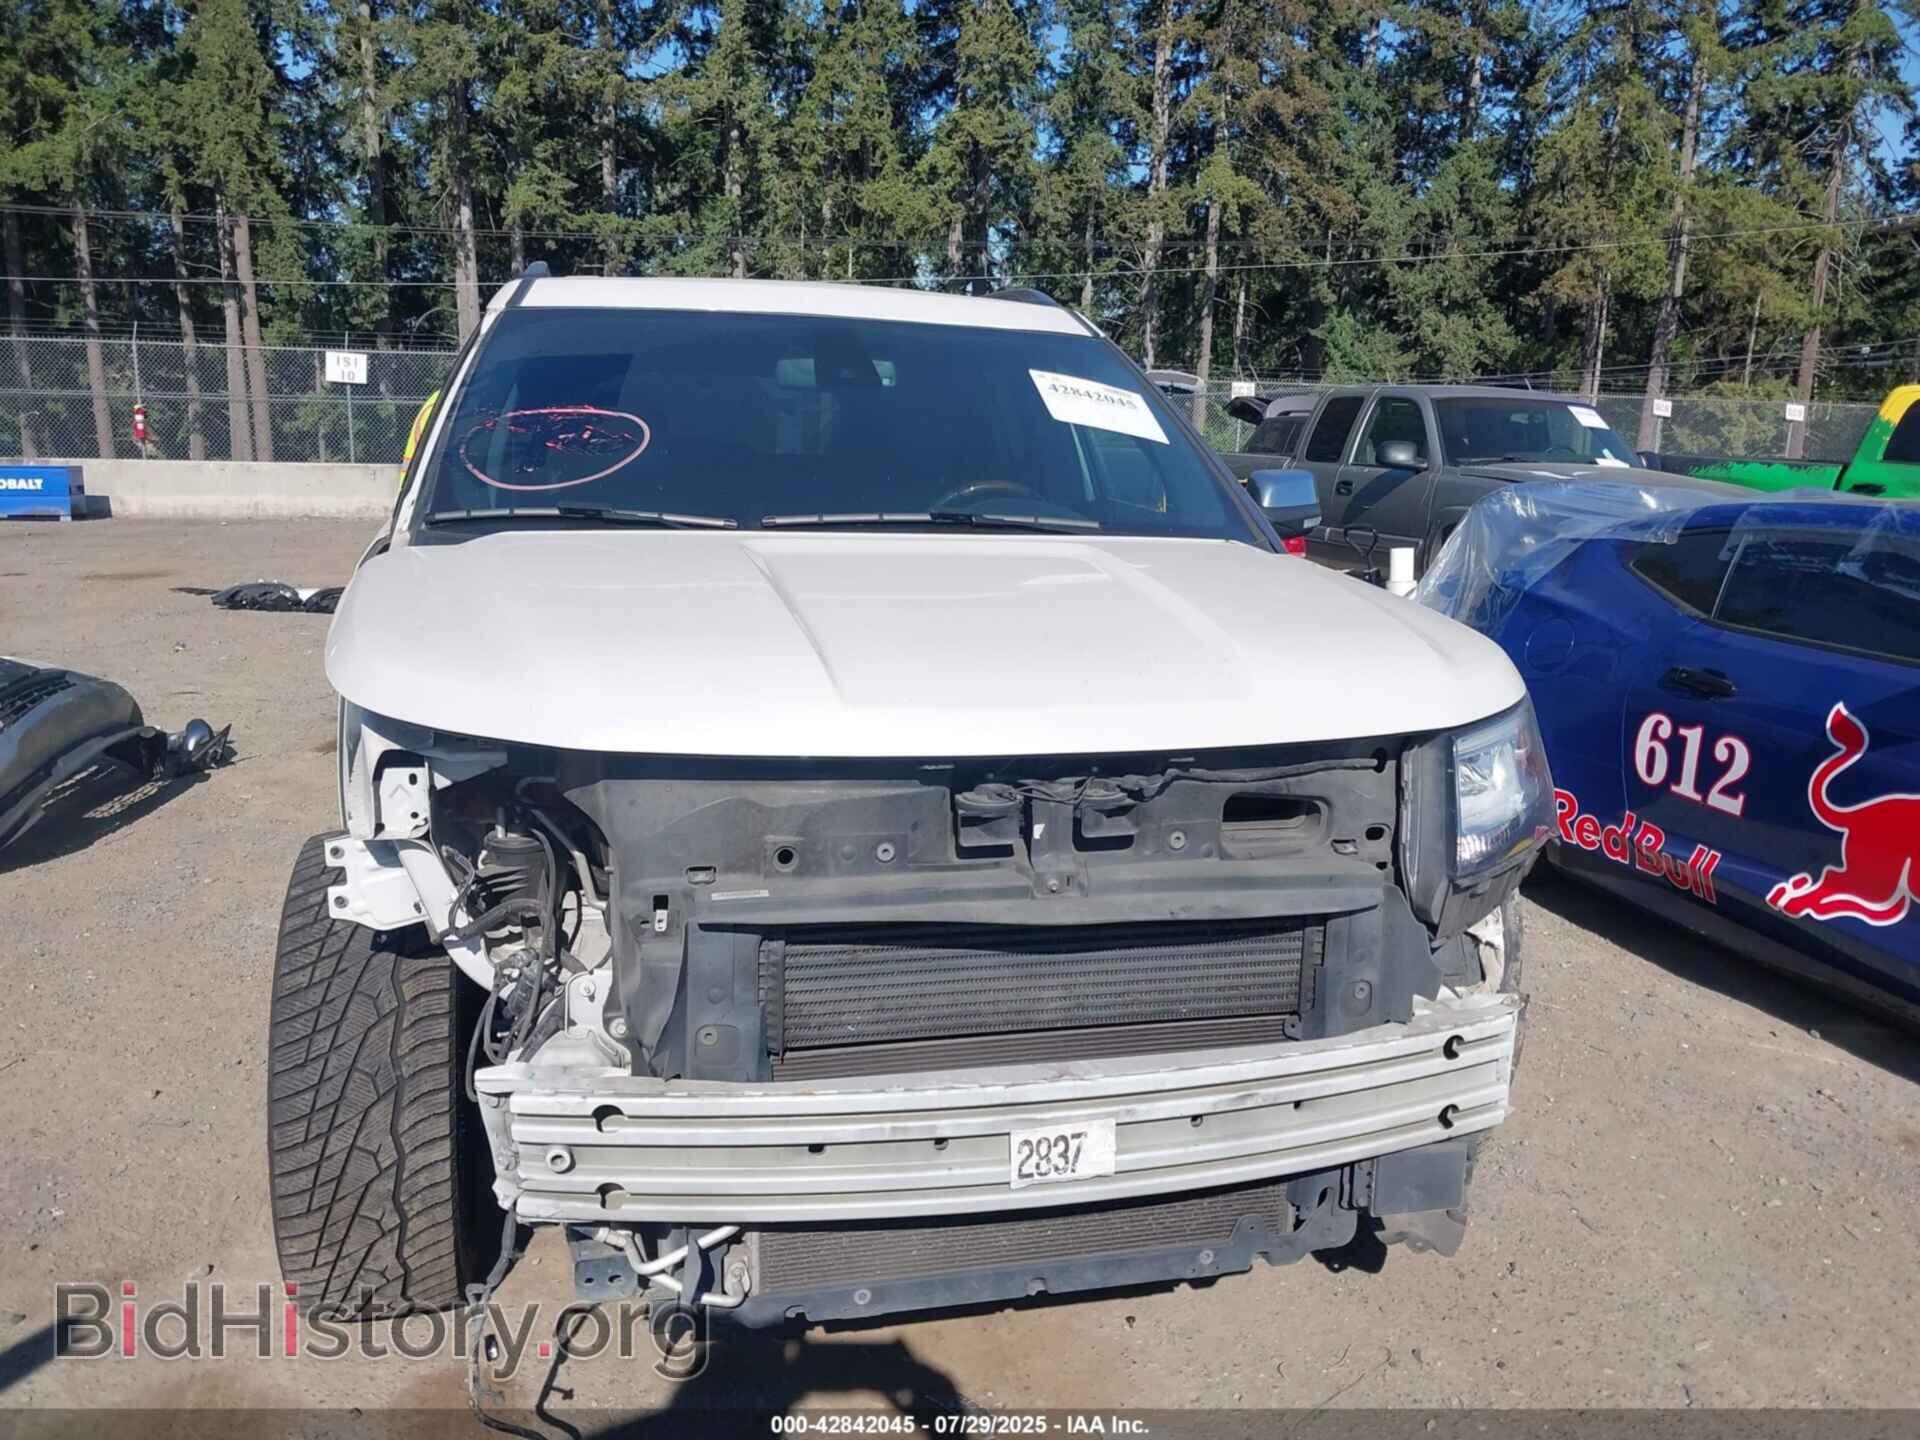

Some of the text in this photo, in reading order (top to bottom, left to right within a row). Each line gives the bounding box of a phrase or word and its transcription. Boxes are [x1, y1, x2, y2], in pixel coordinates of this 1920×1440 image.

[1634, 713, 1750, 817] 612
[1554, 788, 1722, 905] Red Bull
[1017, 1131, 1088, 1180] 2837
